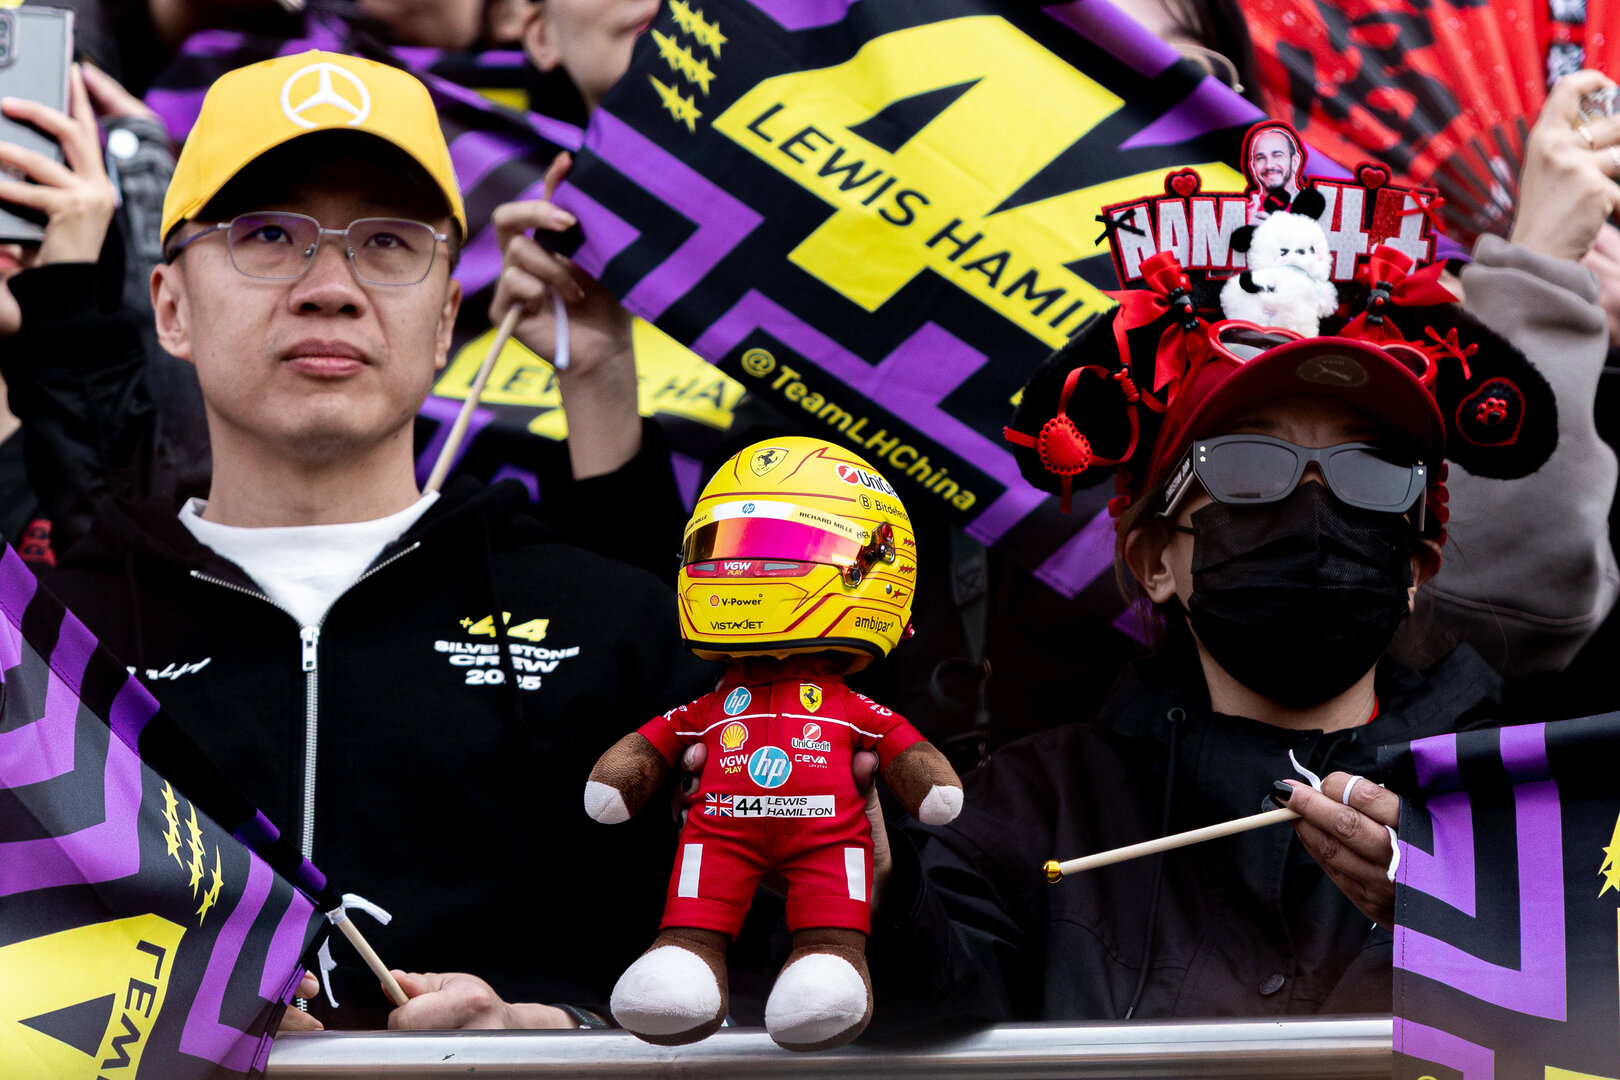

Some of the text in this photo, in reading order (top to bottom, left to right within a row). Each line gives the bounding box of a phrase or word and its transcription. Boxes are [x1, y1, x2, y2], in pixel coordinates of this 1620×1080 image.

[745, 102, 931, 227] LEWIS
[741, 348, 977, 512] @TeamLHChina
[799, 511, 832, 525] RICHARD
[833, 521, 853, 533] MILLE
[724, 562, 751, 571] VGW
[721, 598, 762, 606] V-Power
[465, 668, 541, 691] 205
[726, 687, 750, 715] hp
[792, 738, 831, 752] UniCredit
[720, 754, 749, 768] VGW
[724, 765, 743, 775] PLAY
[752, 746, 788, 788] hp
[735, 797, 808, 816] 44 LEWIS
[766, 807, 833, 816] HAMILTON
